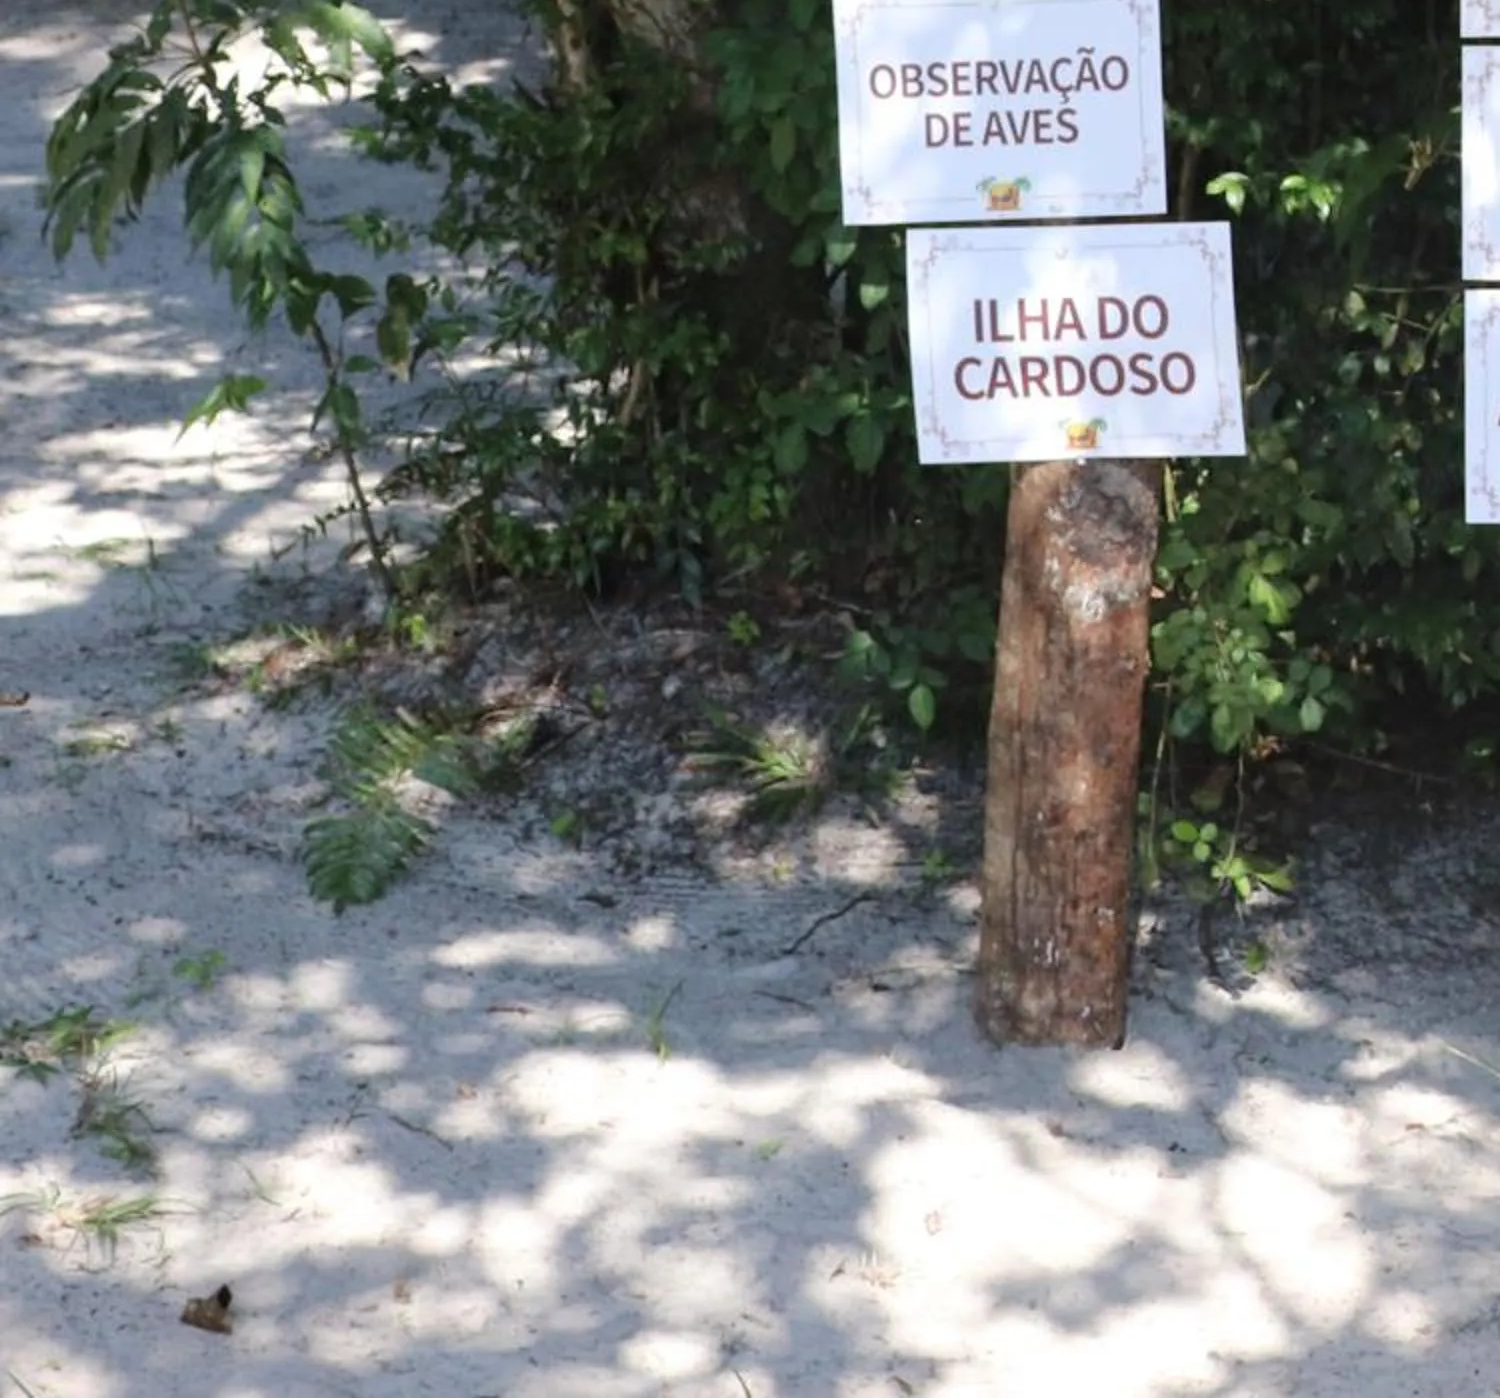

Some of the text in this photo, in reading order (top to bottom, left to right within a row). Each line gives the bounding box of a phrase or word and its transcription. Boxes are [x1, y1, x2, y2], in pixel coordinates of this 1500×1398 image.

[870, 46, 1129, 104] OBSERVAÇÃO
[925, 108, 1079, 148] DE AVES
[974, 295, 1169, 343] ILHA DO
[954, 352, 1195, 401] CARDOSO
